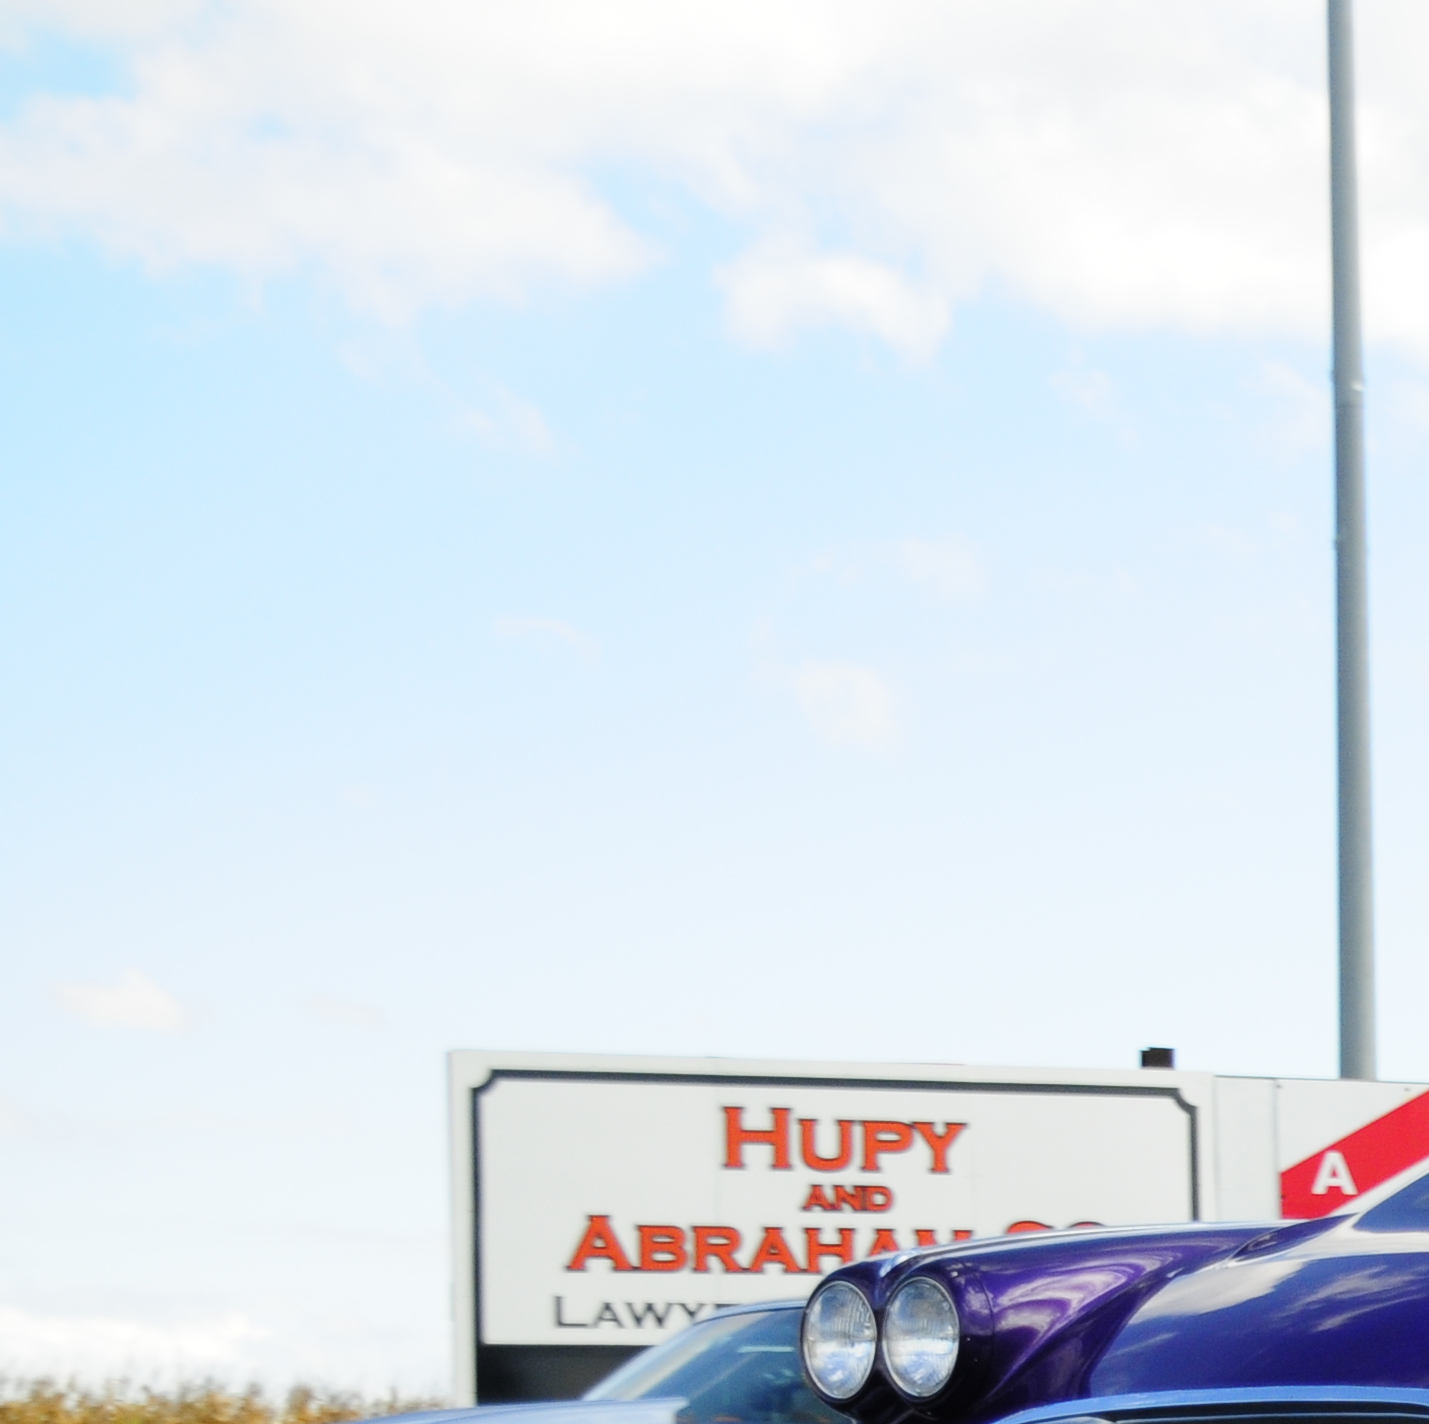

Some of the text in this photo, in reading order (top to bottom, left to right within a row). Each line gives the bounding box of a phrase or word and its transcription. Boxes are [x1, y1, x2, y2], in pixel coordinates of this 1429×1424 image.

[722, 1106, 967, 1174] HUPY
[1311, 1152, 1358, 1195] A
[802, 1185, 894, 1212] AND
